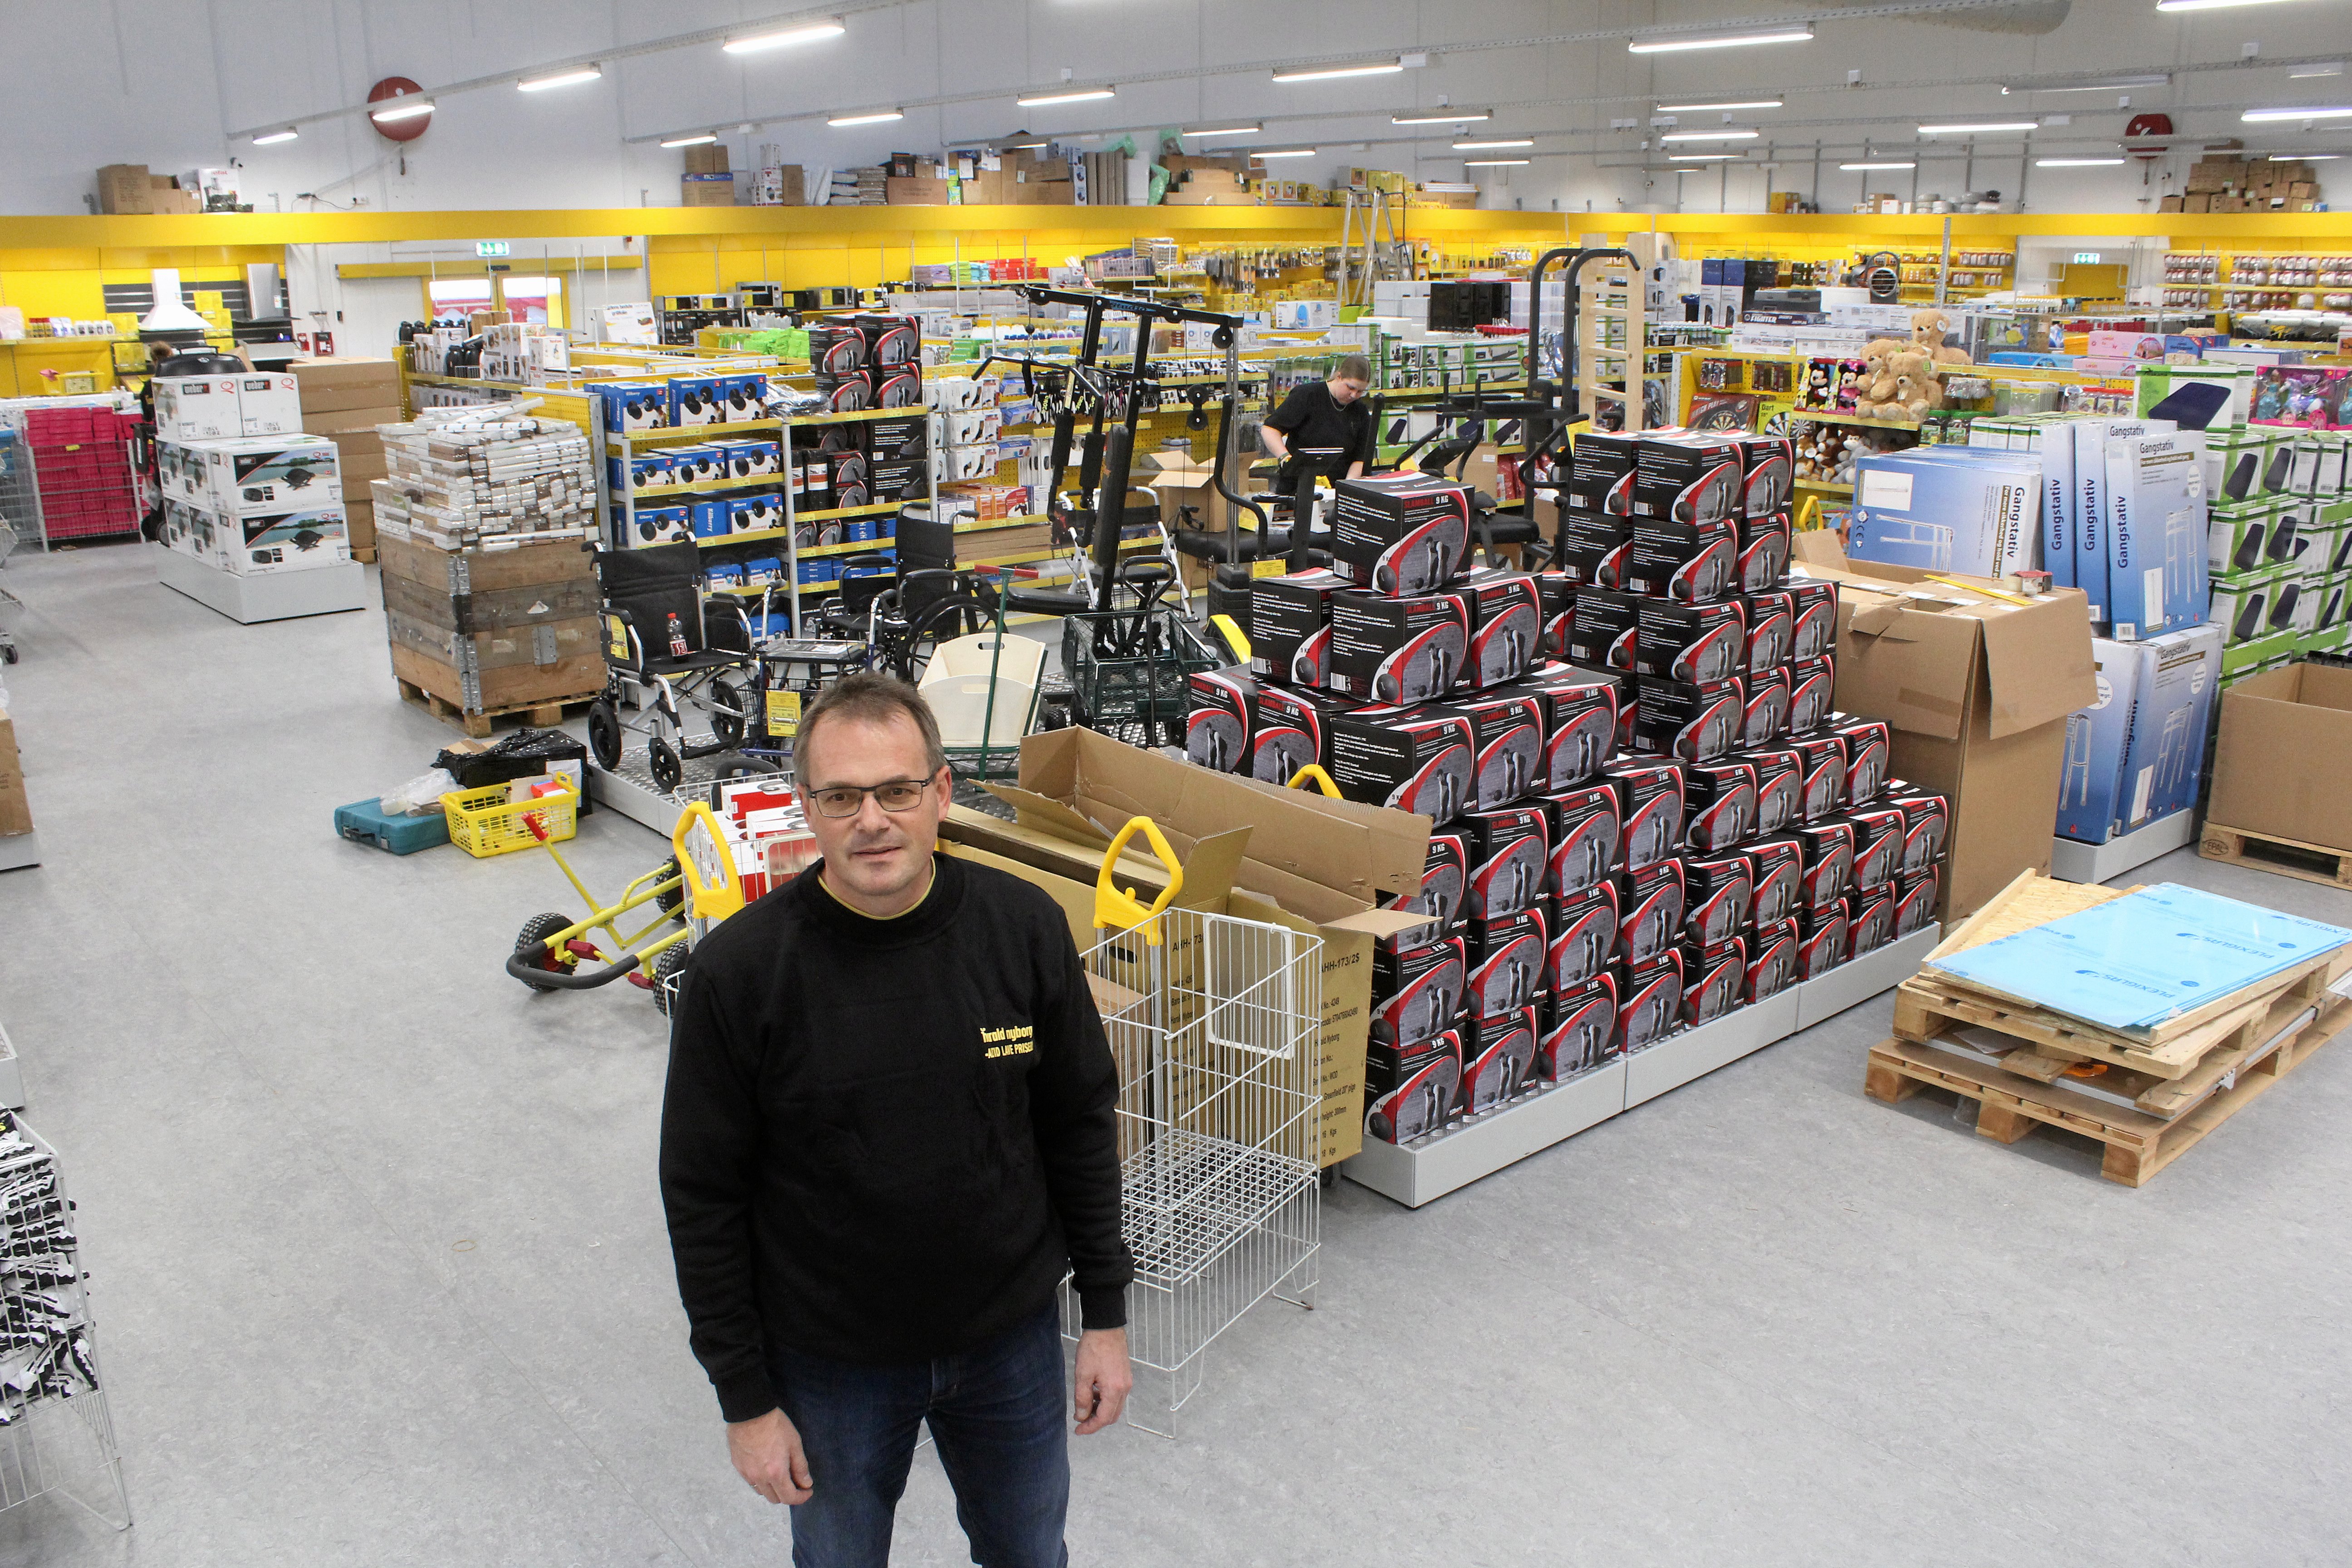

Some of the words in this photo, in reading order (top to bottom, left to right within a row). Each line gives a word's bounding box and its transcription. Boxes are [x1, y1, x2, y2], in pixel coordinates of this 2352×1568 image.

[1750, 314, 1777, 323] FIGHTER
[184, 384, 203, 394] weber
[246, 381, 265, 390] weber
[2110, 425, 2145, 438] Gangstativ
[2139, 439, 2174, 454] Gangstativ
[1404, 498, 1434, 508] SLAMBALL
[2007, 486, 2025, 558] Gangstativ
[2051, 479, 2064, 550] Gangstativ
[2084, 479, 2098, 550] Gangstativ
[2117, 495, 2130, 568] Gangstativ
[1480, 588, 1507, 600] SLAMBALL
[1513, 584, 1520, 593] KG
[1406, 604, 1435, 613] SLAMBALL
[1441, 601, 1448, 609] KG
[2160, 643, 2192, 660] Gangstativ
[1191, 679, 1215, 692] SLAMBALL
[1215, 688, 1220, 696] 9
[1220, 689, 1228, 699] KG
[1557, 692, 1584, 703] SLAMBALL
[1586, 689, 1590, 697] 9
[1591, 688, 1598, 696] KG
[1286, 705, 1290, 714] 9
[1291, 706, 1299, 715] KG
[1480, 710, 1509, 722] SLAMBALL
[1515, 706, 1523, 715] KG
[1416, 731, 1441, 742] SLAMBALL
[1444, 726, 1447, 734] 9
[1448, 724, 1455, 733] KG
[1662, 772, 1668, 781] KG
[1593, 793, 1601, 801] KG
[1492, 819, 1518, 828] SLAMBALL
[1519, 816, 1523, 824] 9
[1524, 815, 1530, 823] KG
[1432, 845, 1436, 853] 9
[1437, 843, 1445, 852] KG
[1562, 894, 1587, 907] SLAMBALL
[1489, 919, 1515, 930] SLAMBALL
[1438, 942, 1447, 951] KG
[2203, 936, 2275, 958] PLEXIGLAS
[1662, 956, 1669, 964] KG
[1559, 988, 1585, 1000] SLAMBALL
[1592, 980, 1598, 989] KG
[2102, 974, 2176, 998] PLEXIGLAS
[1481, 1016, 1508, 1028] SLAMBALL
[1514, 1011, 1522, 1019] KG
[980, 1027, 1006, 1043] hrald
[1006, 1025, 1033, 1042] nyborg
[1315, 1036, 1327, 1047] Hald
[1400, 1045, 1431, 1058] SLAMBALL
[1436, 1037, 1445, 1046] KG
